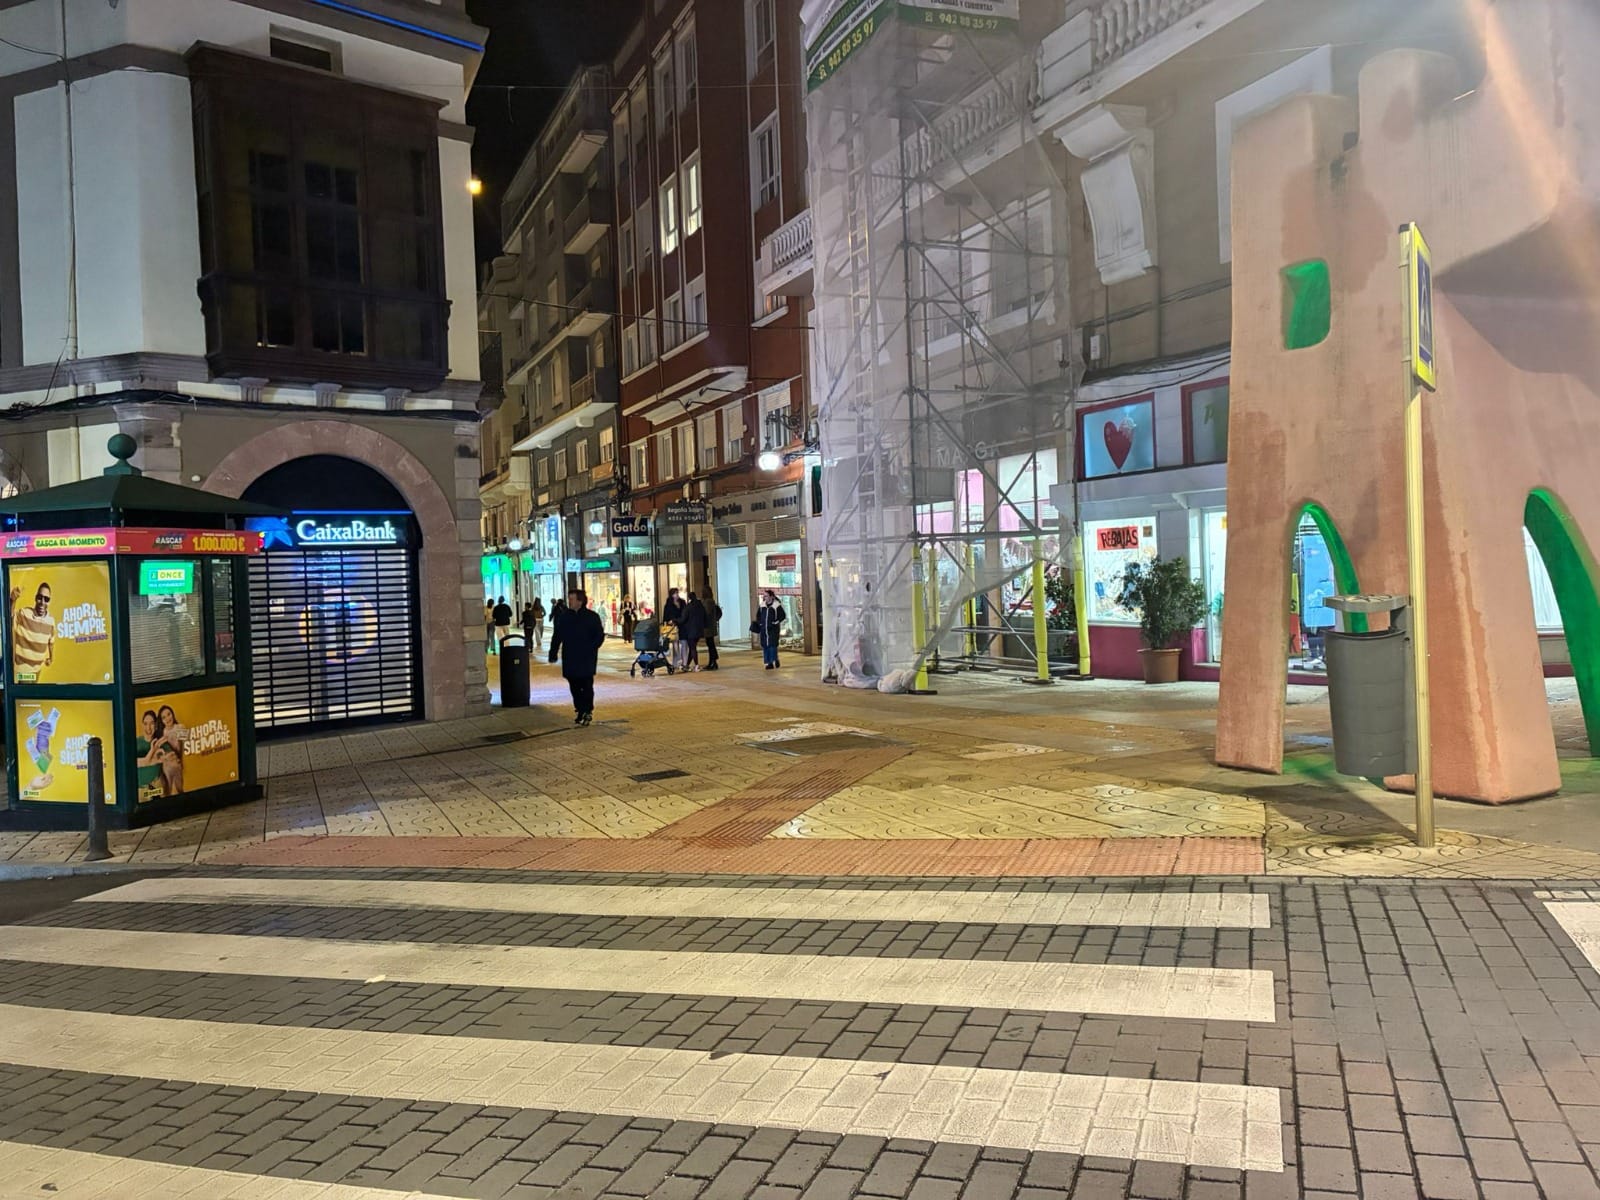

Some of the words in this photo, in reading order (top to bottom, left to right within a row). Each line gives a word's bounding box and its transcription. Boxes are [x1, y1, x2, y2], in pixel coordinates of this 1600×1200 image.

[939, 13, 957, 24] 942
[972, 18, 984, 28] 35
[986, 19, 998, 29] 97
[828, 49, 841, 71] 942
[841, 38, 851, 57] 88
[852, 28, 863, 47] 35
[863, 17, 874, 37] 97
[296, 520, 396, 541] CaixaBank
[1101, 528, 1138, 549] REBAJAS
[36, 539, 58, 547] RASCA
[59, 538, 67, 546] EL
[69, 537, 105, 546] MOMENTO
[159, 571, 183, 579] ONCE
[63, 602, 97, 622] AHORA
[57, 618, 106, 639] SIEMPRE
[190, 719, 223, 740] AHORA
[184, 730, 231, 756] SIEMPRE
